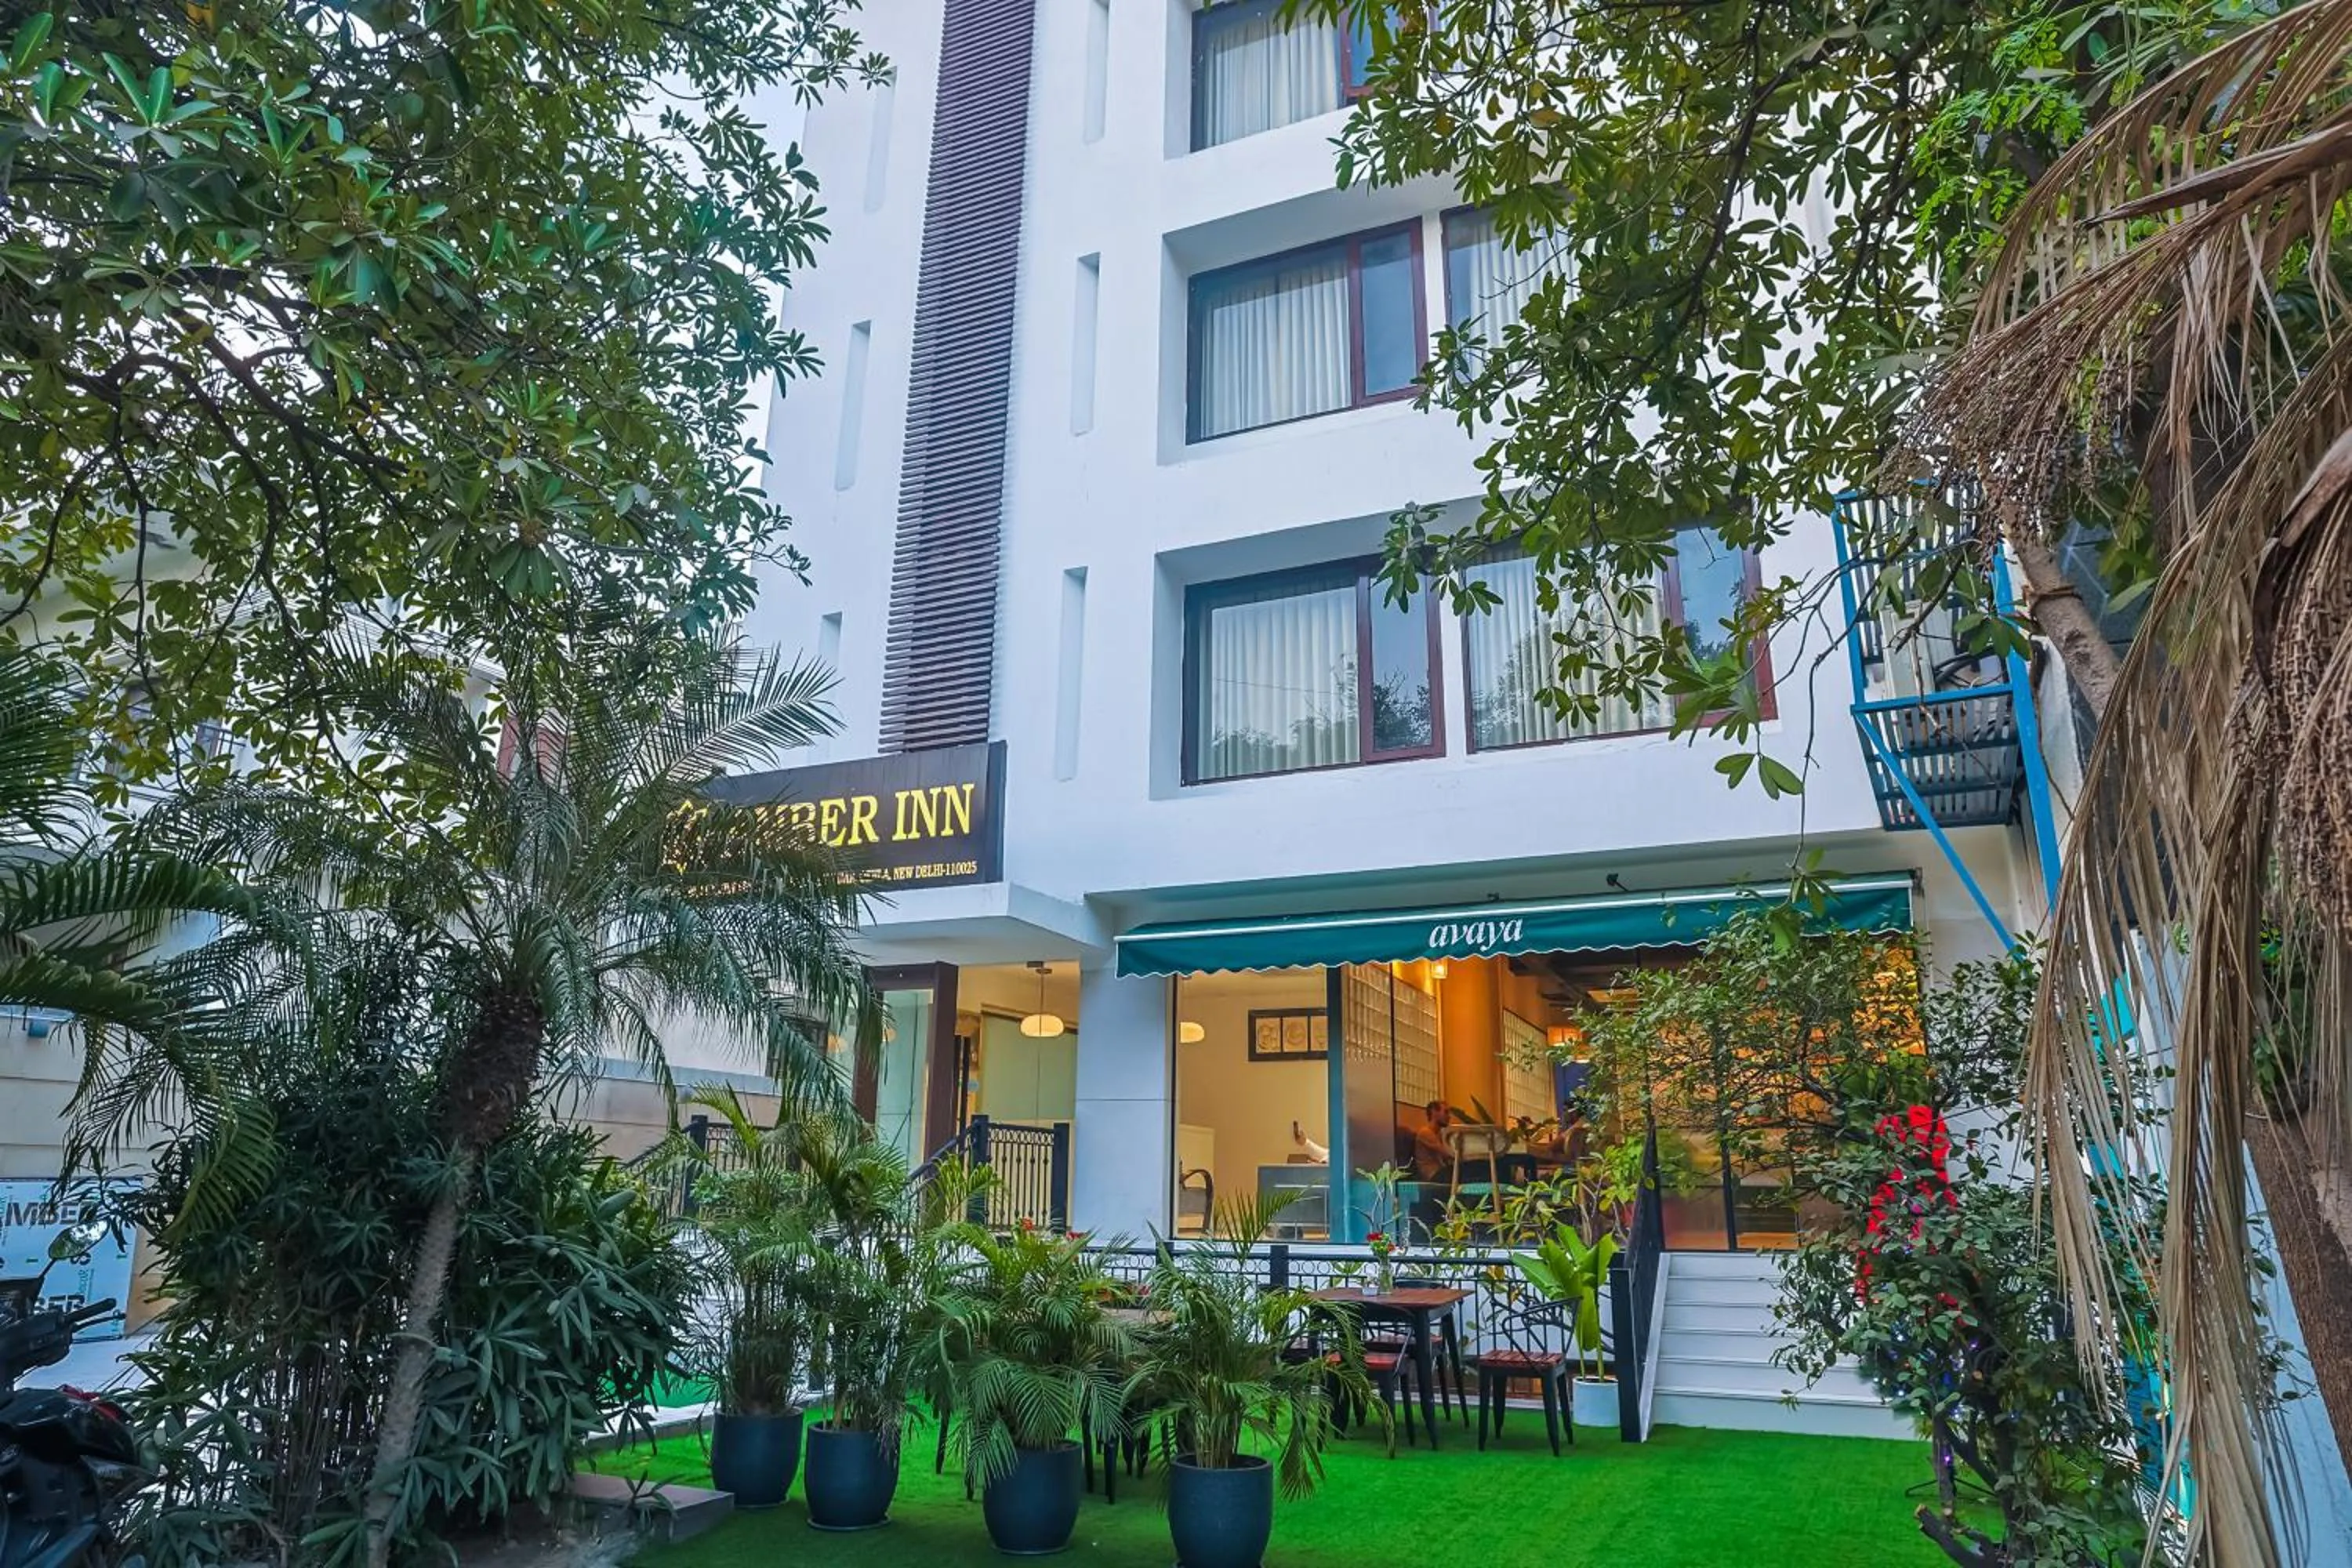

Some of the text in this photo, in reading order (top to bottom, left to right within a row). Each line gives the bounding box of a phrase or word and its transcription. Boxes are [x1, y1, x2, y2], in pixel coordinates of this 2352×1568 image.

[892, 783, 975, 840] INN
[894, 866, 914, 880] NEW
[915, 860, 978, 879] DELHI-110025
[1428, 918, 1523, 952] avaya
